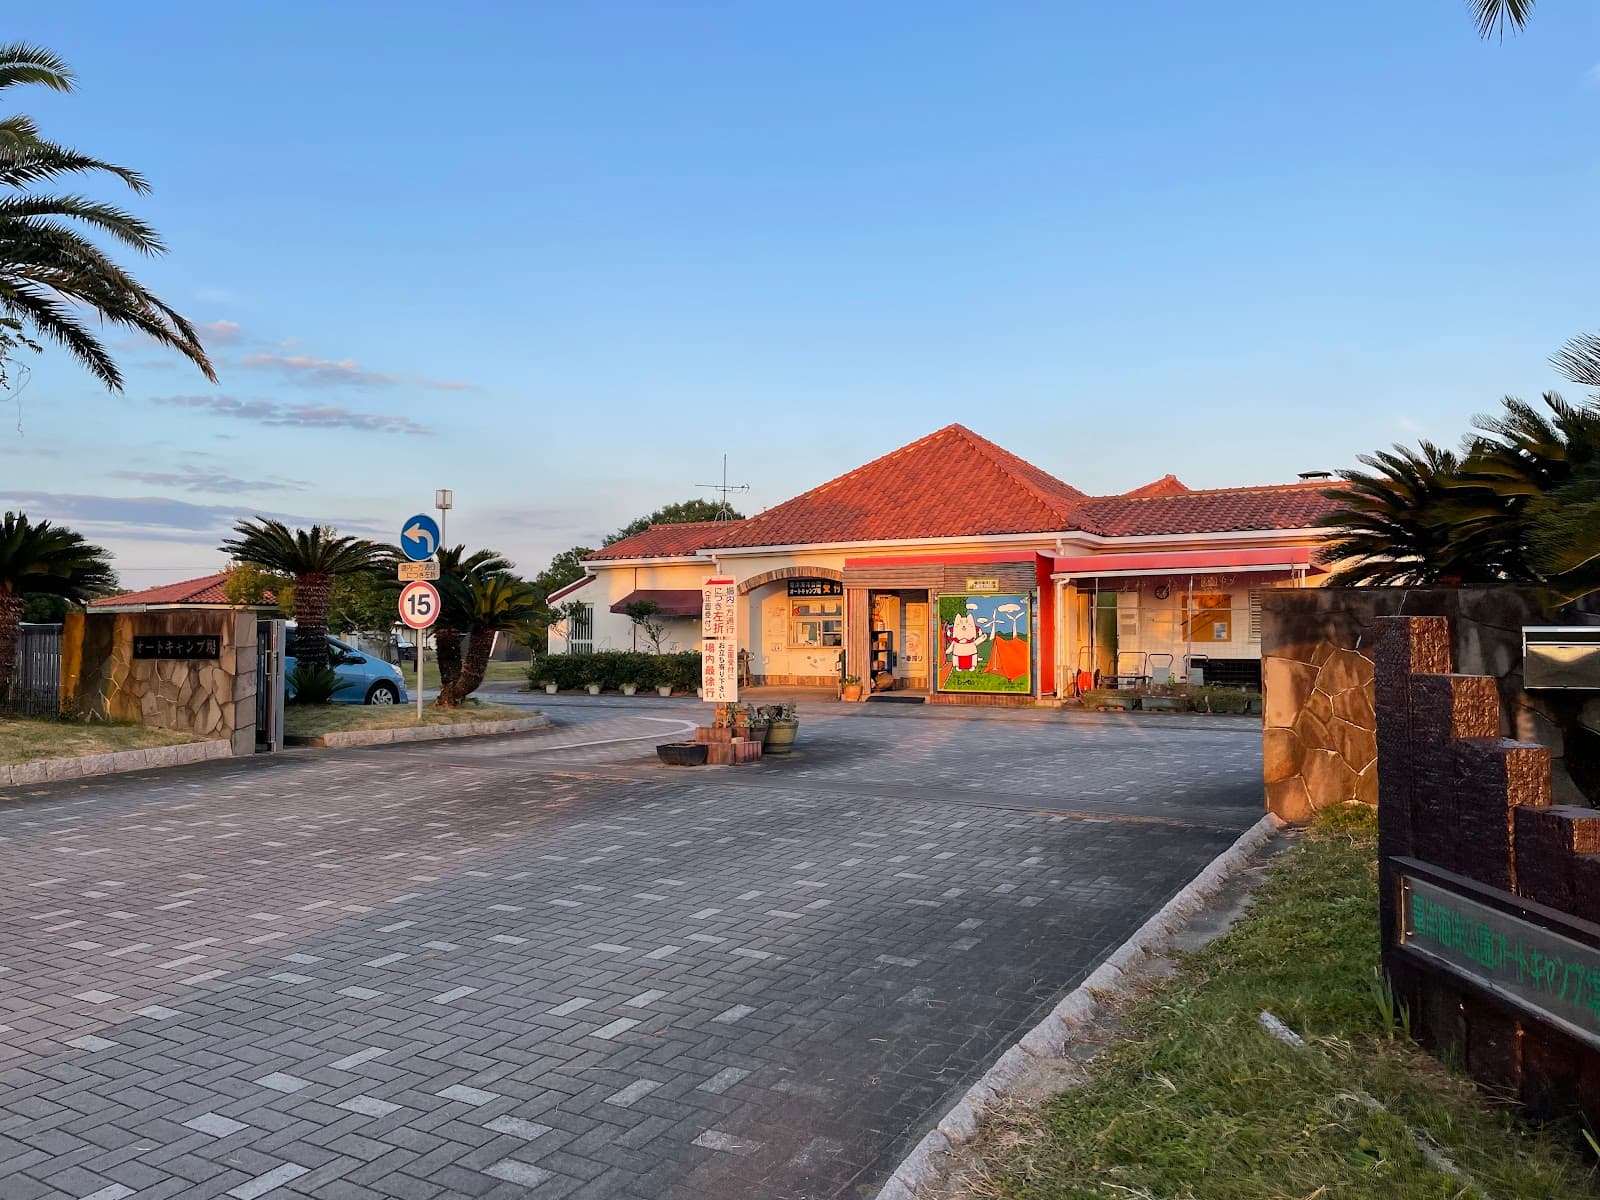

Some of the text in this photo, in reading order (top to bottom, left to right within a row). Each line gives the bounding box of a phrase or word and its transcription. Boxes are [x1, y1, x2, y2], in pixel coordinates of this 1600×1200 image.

[407, 594, 431, 616] 15
[713, 587, 724, 634] につき左折
[136, 639, 217, 655] オートキャンプ場
[704, 642, 715, 698] 場内最徐行
